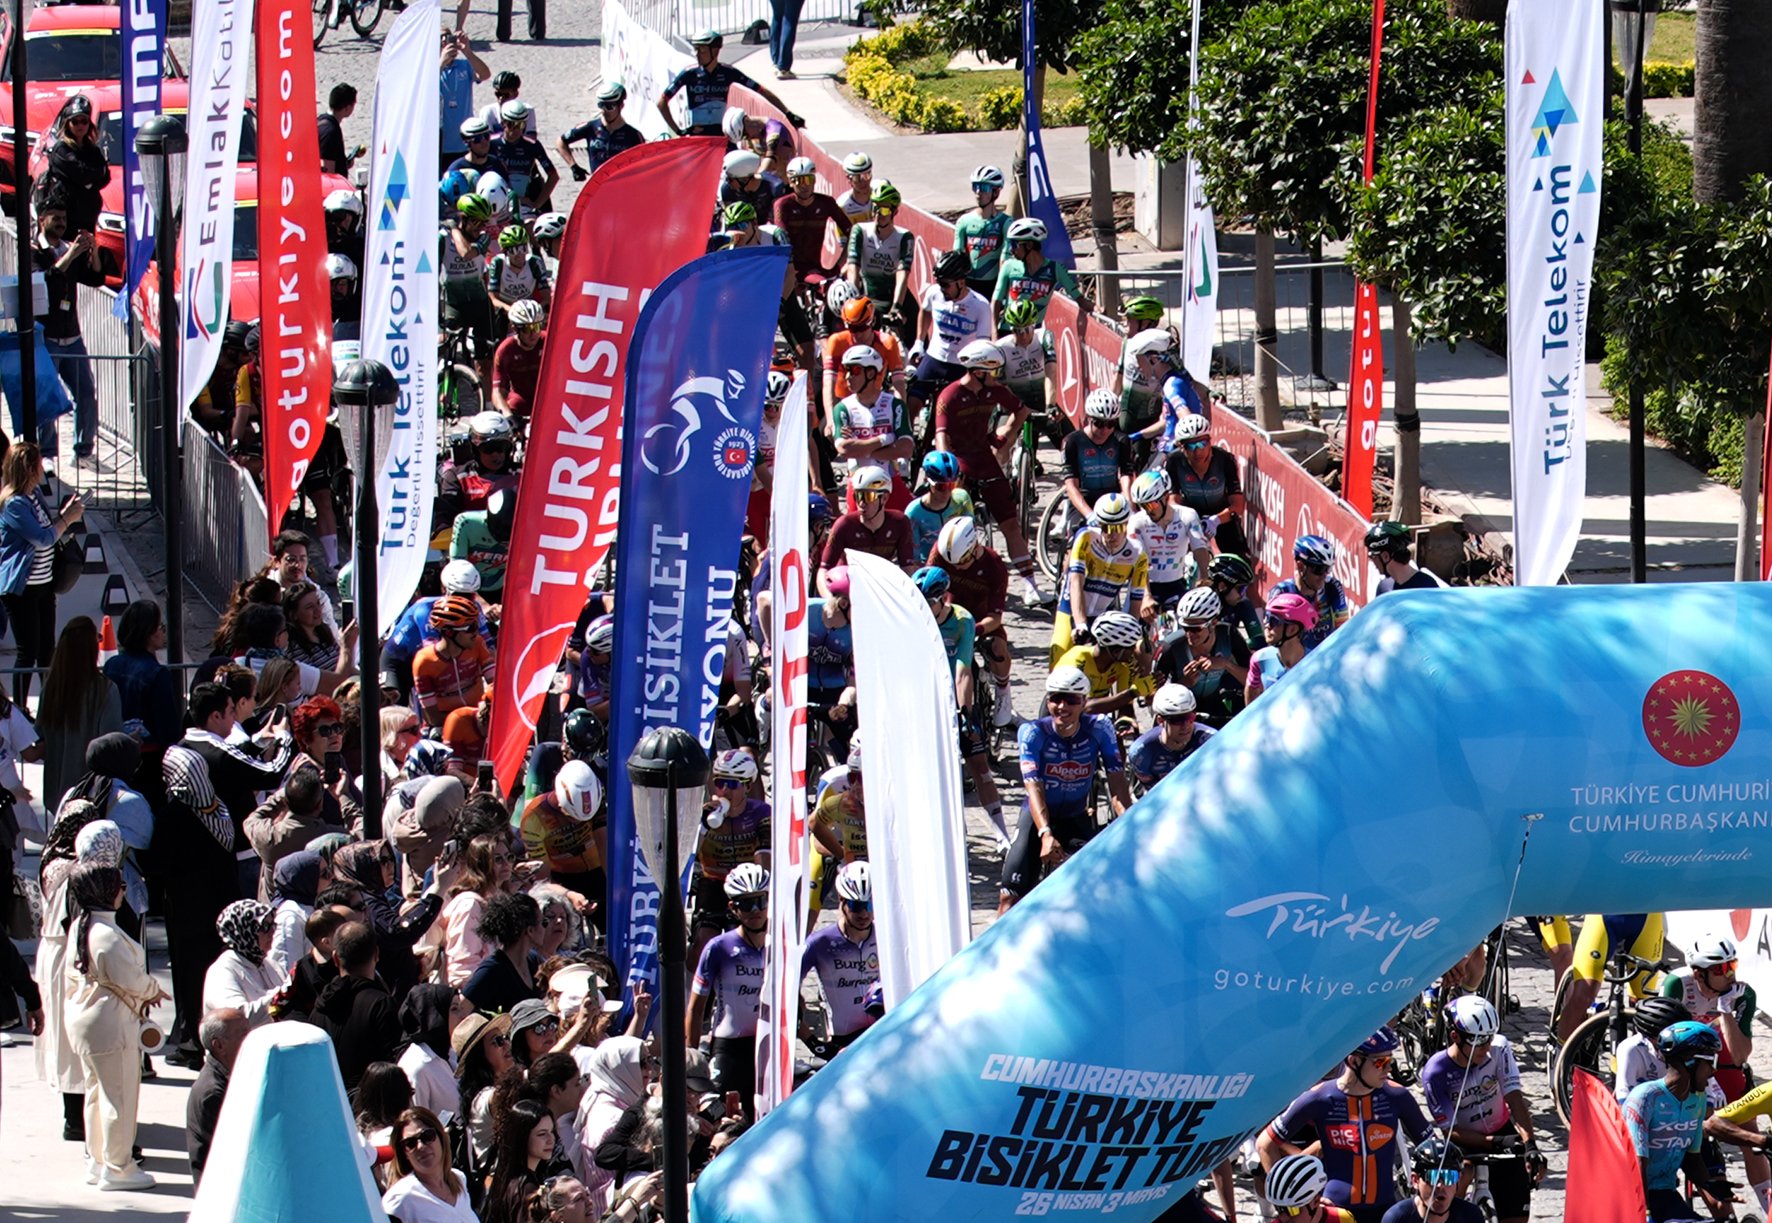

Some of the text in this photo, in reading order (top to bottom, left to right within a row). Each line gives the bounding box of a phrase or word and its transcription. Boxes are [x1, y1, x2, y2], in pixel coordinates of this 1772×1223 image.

[1541, 164, 1572, 476] Türk Telekom
[406, 360, 425, 548] Değerli Hissettirir
[530, 281, 629, 595] TURKISH
[380, 456, 411, 556] Türk
[634, 524, 689, 738] İSİKLET
[1049, 765, 1090, 777] Alpecin
[1570, 783, 1661, 806] TÜRKİYE
[1620, 847, 1754, 867] Himayelerinde
[1224, 890, 1441, 974] Türkiye
[1212, 968, 1415, 999] goturkiye.com
[1010, 1086, 1217, 1145] TÜRKİYE
[925, 1126, 1256, 1191] BİSİKLET TURU
[1015, 1184, 1172, 1216] 26 NİSAN 3 MAYIS
